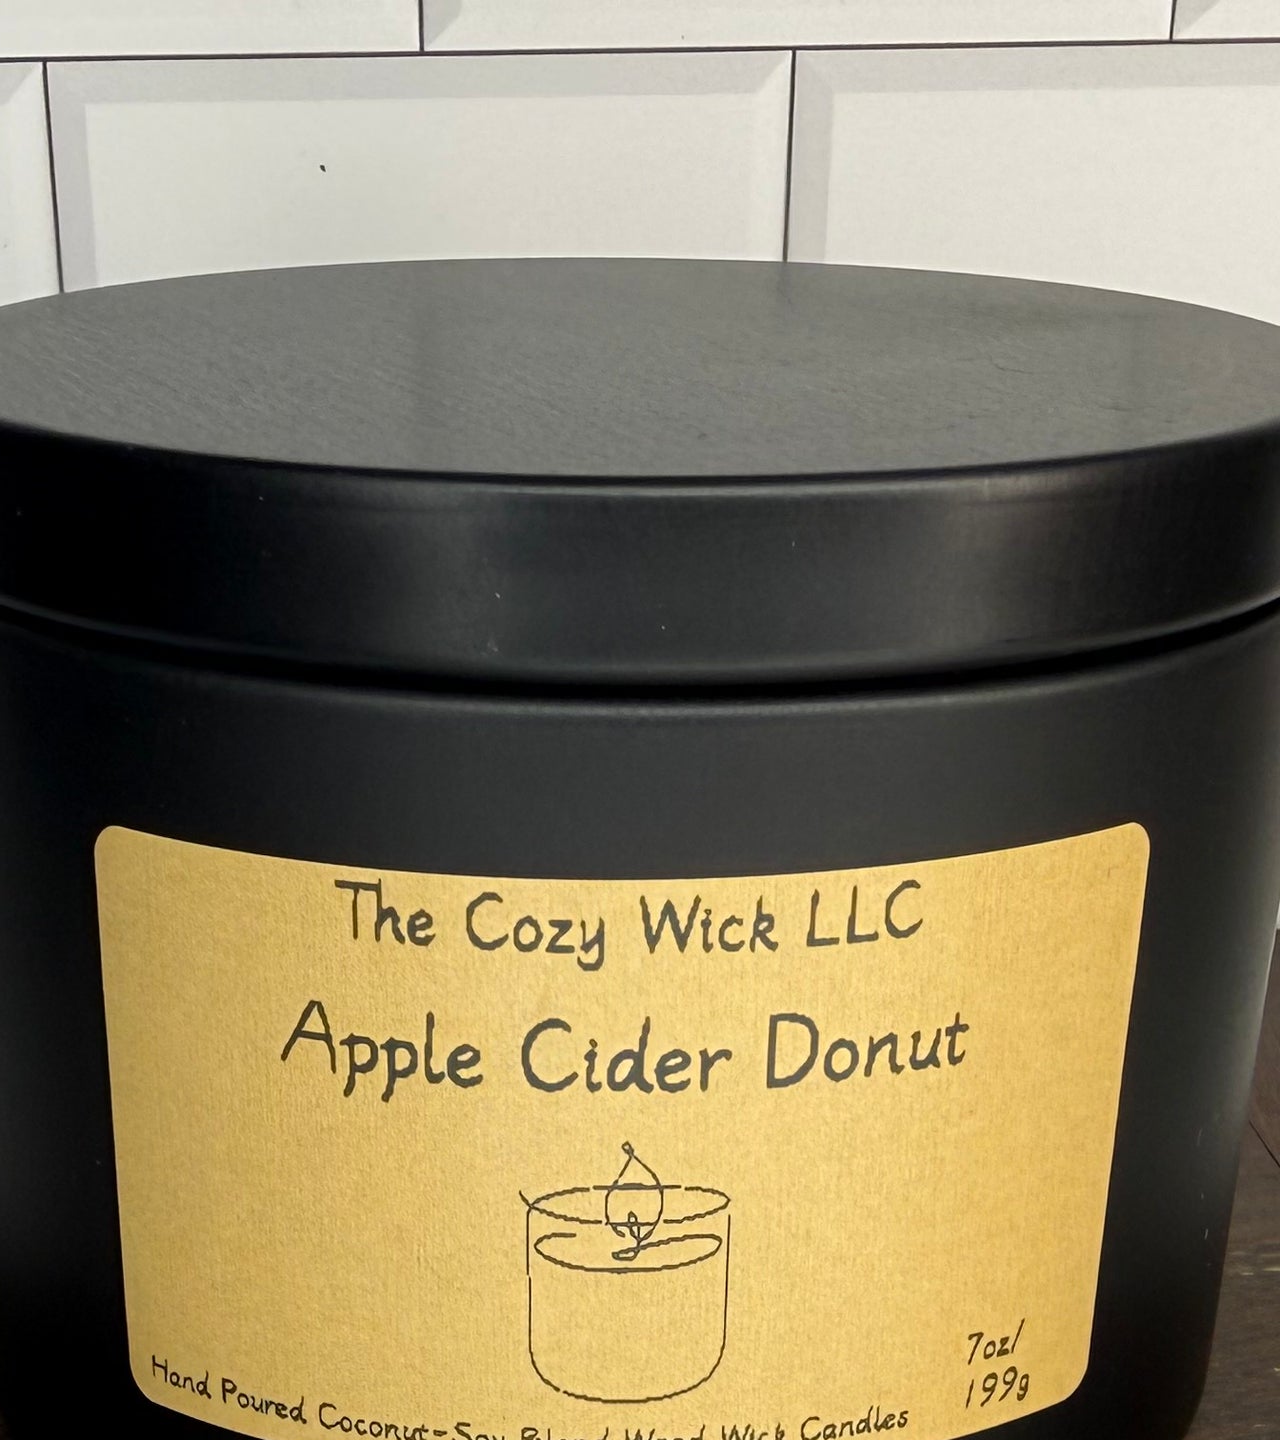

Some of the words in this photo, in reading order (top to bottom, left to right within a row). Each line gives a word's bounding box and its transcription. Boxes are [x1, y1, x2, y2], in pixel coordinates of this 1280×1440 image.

[334, 877, 437, 948] The
[465, 891, 606, 972] Cozy
[639, 894, 779, 955] Wick
[805, 879, 924, 948] LLC
[280, 999, 484, 1104] Apple
[520, 1015, 733, 1095] Cider
[766, 1011, 970, 1090] Donut
[967, 1317, 1026, 1366] 7oz/
[151, 1354, 212, 1400] Hand
[221, 1377, 308, 1425] Poured
[965, 1365, 1030, 1409] 199g
